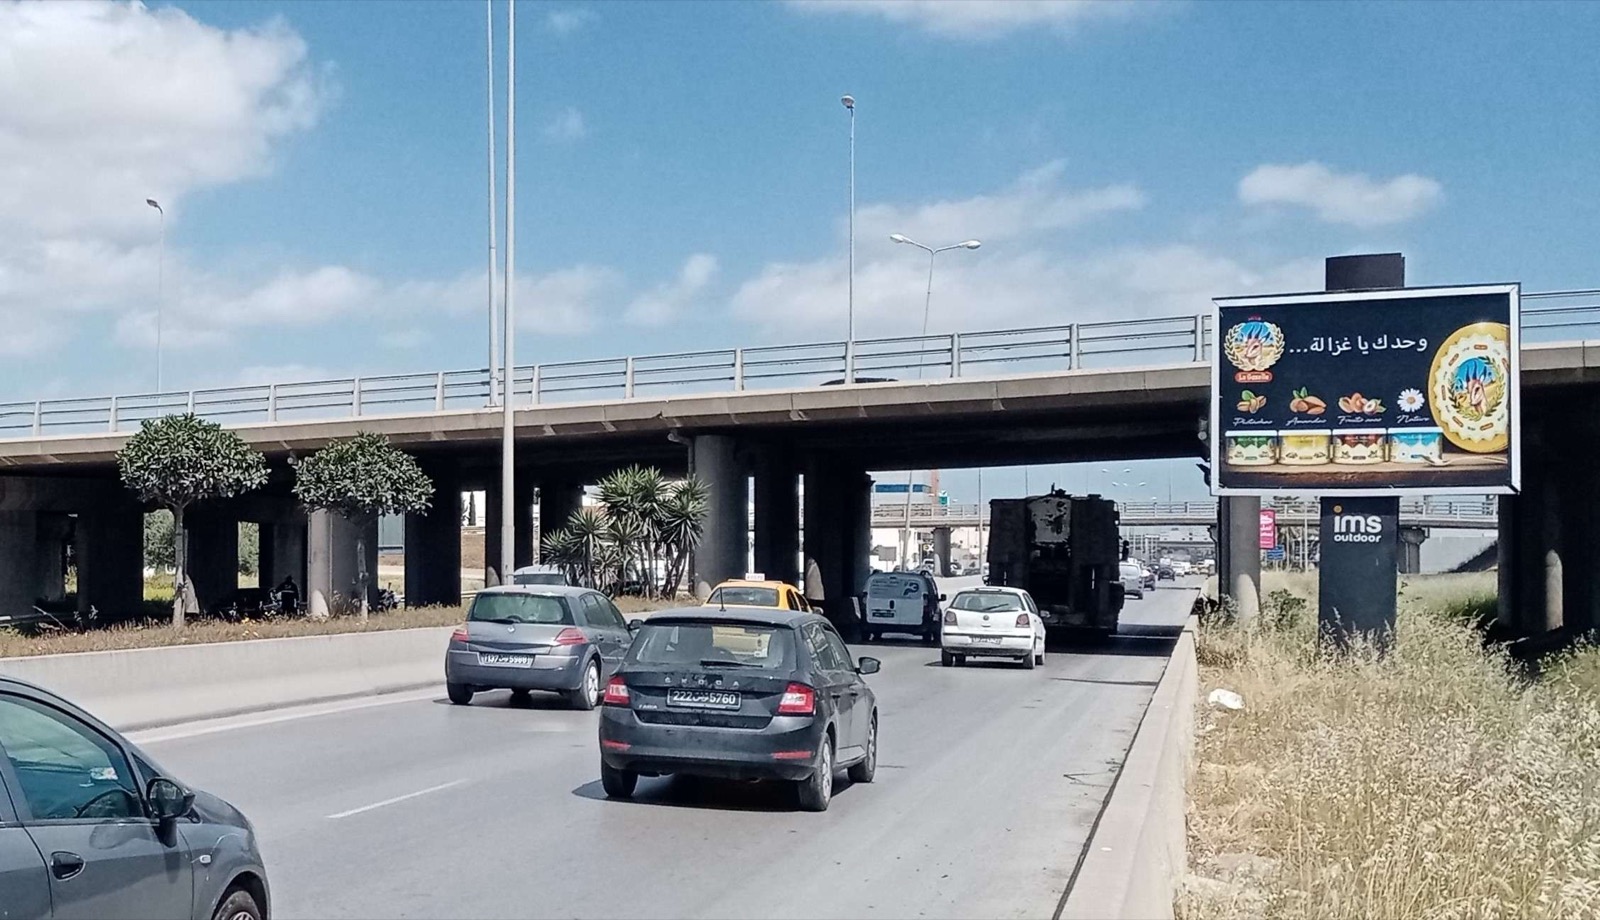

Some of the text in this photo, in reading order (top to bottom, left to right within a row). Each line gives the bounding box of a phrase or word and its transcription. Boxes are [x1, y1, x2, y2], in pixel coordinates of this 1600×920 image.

[1357, 335, 1369, 354] يا
[1372, 334, 1428, 352] وحدك
[1333, 505, 1382, 533] ims
[1333, 533, 1382, 543] outdoor
[673, 690, 692, 701] 222
[709, 693, 736, 705] 5760
